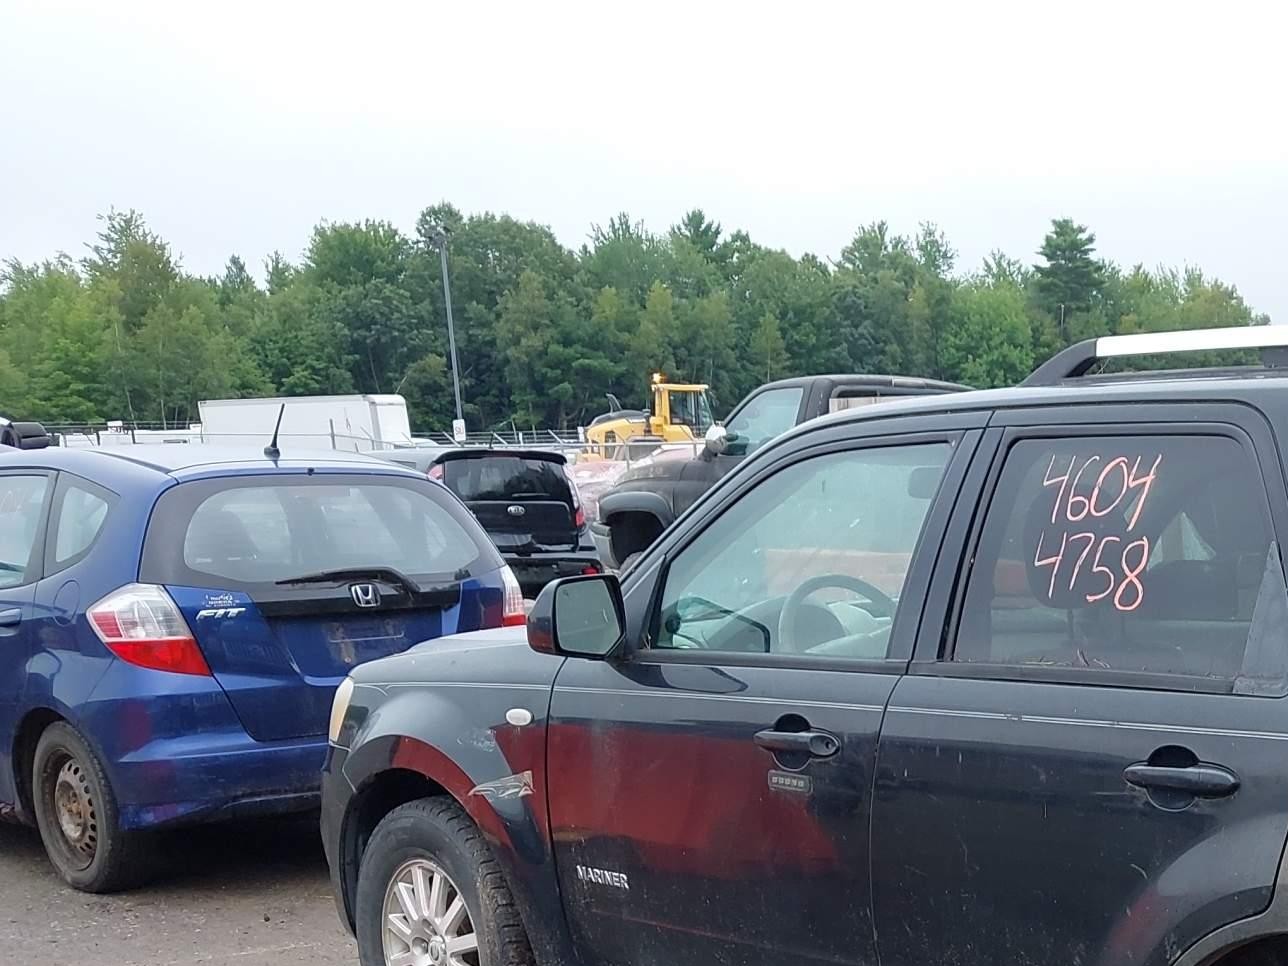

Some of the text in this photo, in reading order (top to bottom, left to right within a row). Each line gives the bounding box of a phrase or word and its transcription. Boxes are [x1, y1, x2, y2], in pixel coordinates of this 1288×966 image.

[1043, 454, 1162, 532] 4604
[1034, 531, 1149, 611] 4758
[195, 607, 246, 620] FIT
[576, 865, 629, 890] MARINER
